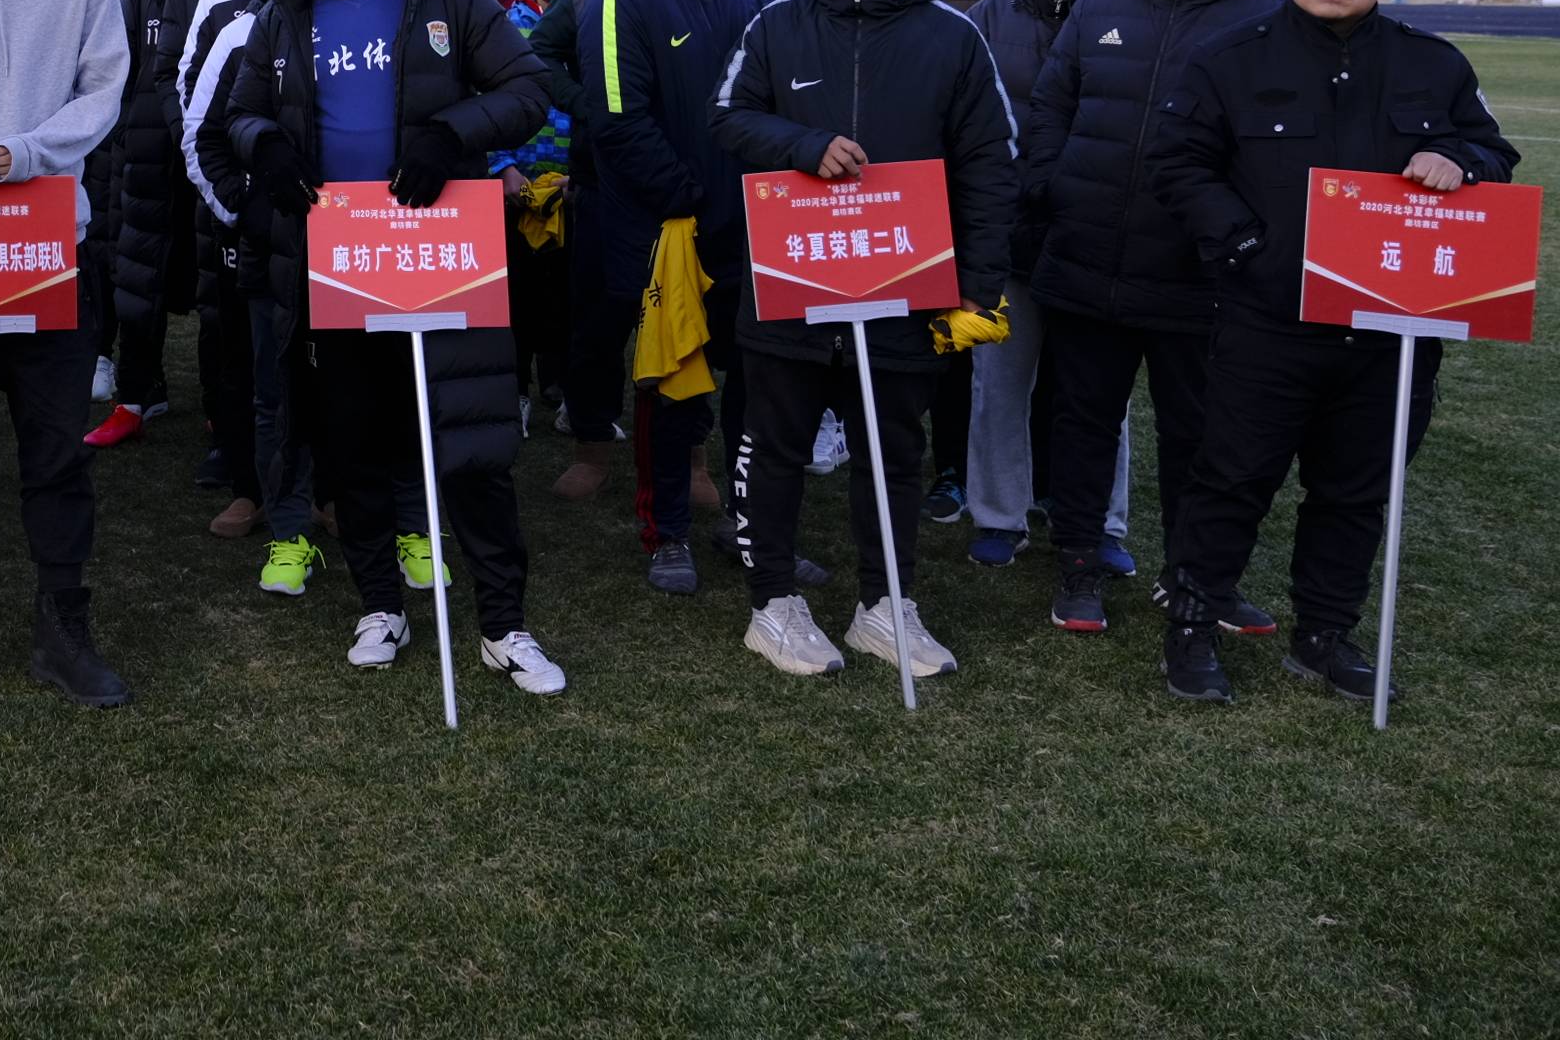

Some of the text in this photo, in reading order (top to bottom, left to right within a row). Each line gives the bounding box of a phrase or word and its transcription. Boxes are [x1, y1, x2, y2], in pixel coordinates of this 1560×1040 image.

[791, 191, 901, 208] 2020河北华夏幸福球迷联赛
[350, 207, 458, 219] 2020河北华夏幸福球迷联赛
[1360, 201, 1486, 222] 2020河北华夏幸福球迷联赛
[786, 226, 914, 263] 华夏荣耀二队
[332, 242, 478, 273] 廊坊广达足球队
